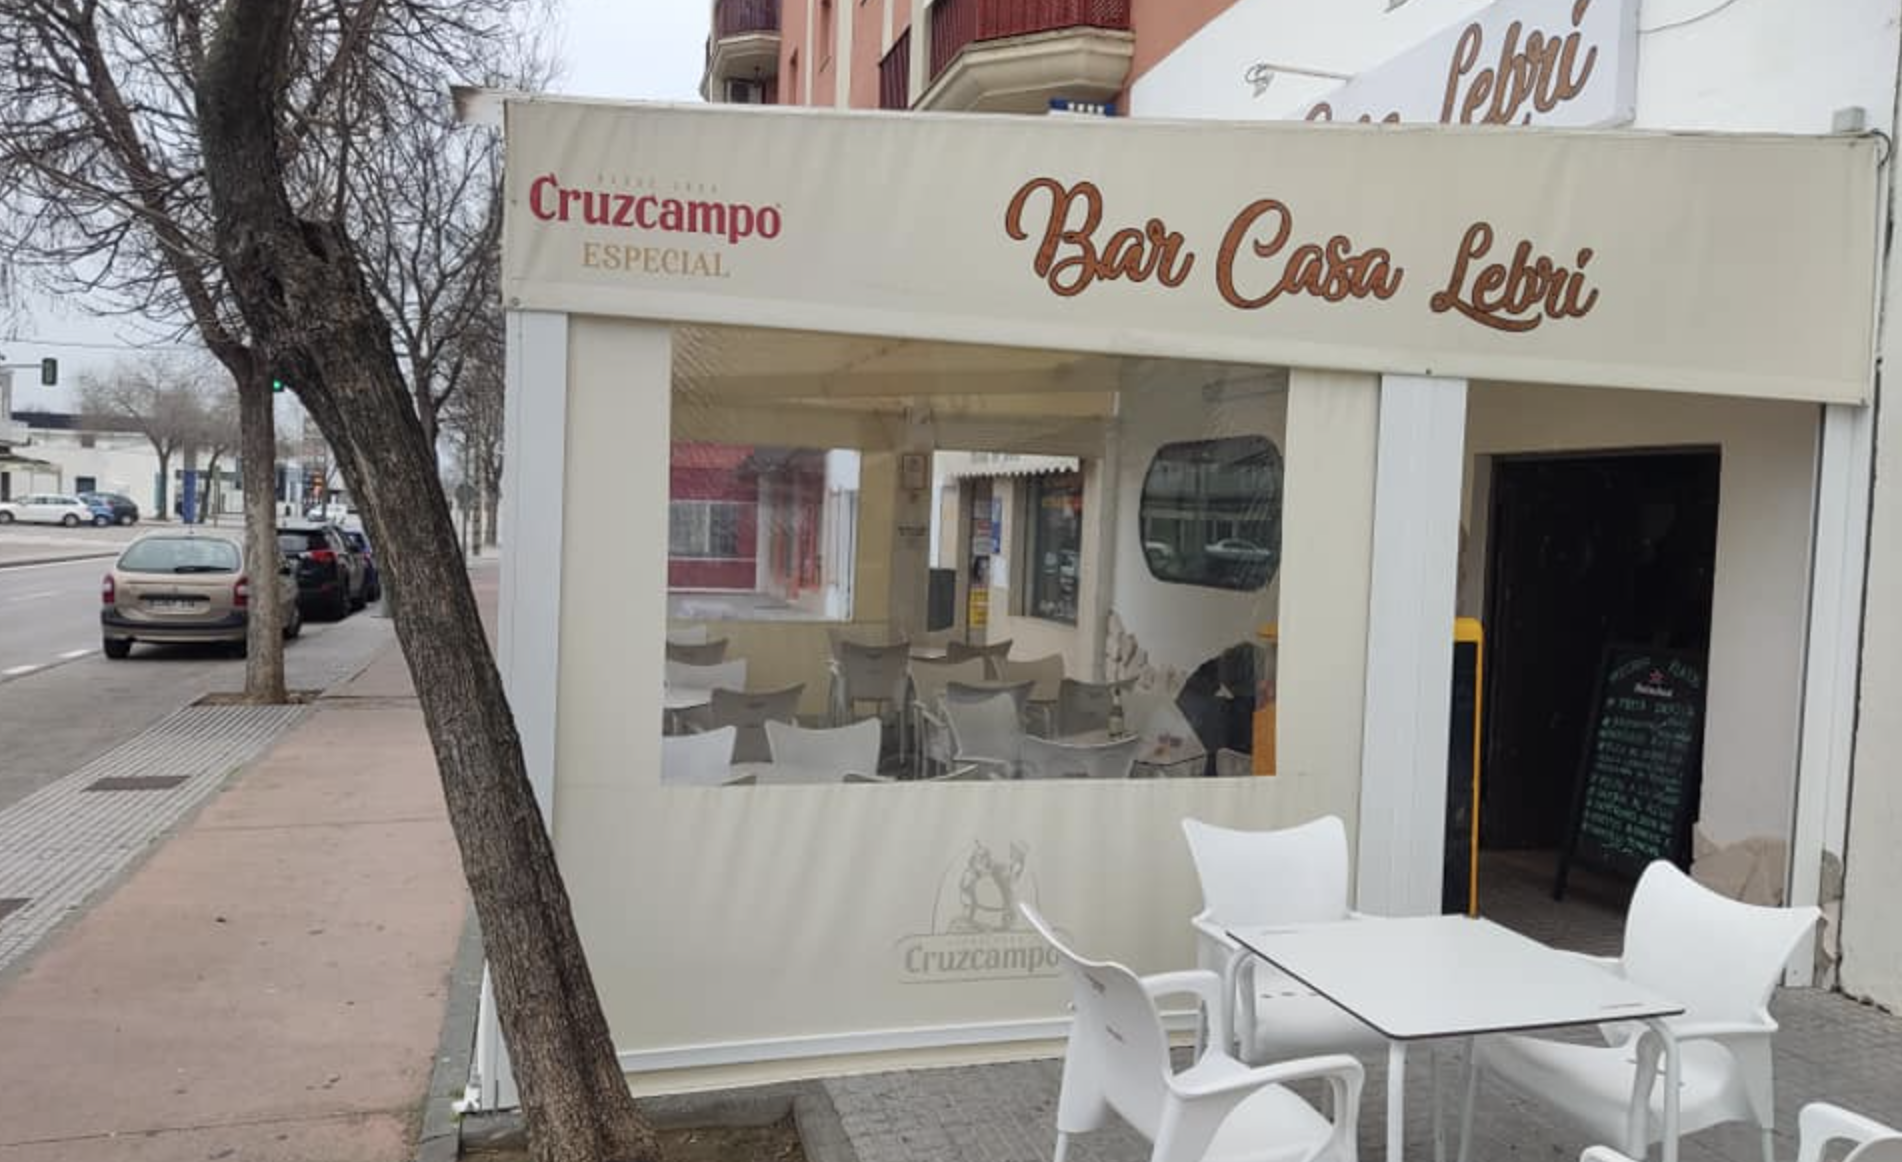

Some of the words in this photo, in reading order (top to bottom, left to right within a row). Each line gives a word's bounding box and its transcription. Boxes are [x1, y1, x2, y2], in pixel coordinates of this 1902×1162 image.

[529, 172, 782, 244] Cruzcampo
[582, 241, 731, 278] ESPECIAL
[1005, 177, 1195, 296] Bar
[1216, 198, 1404, 310] Casa
[904, 945, 1060, 974] Cruzcampo
